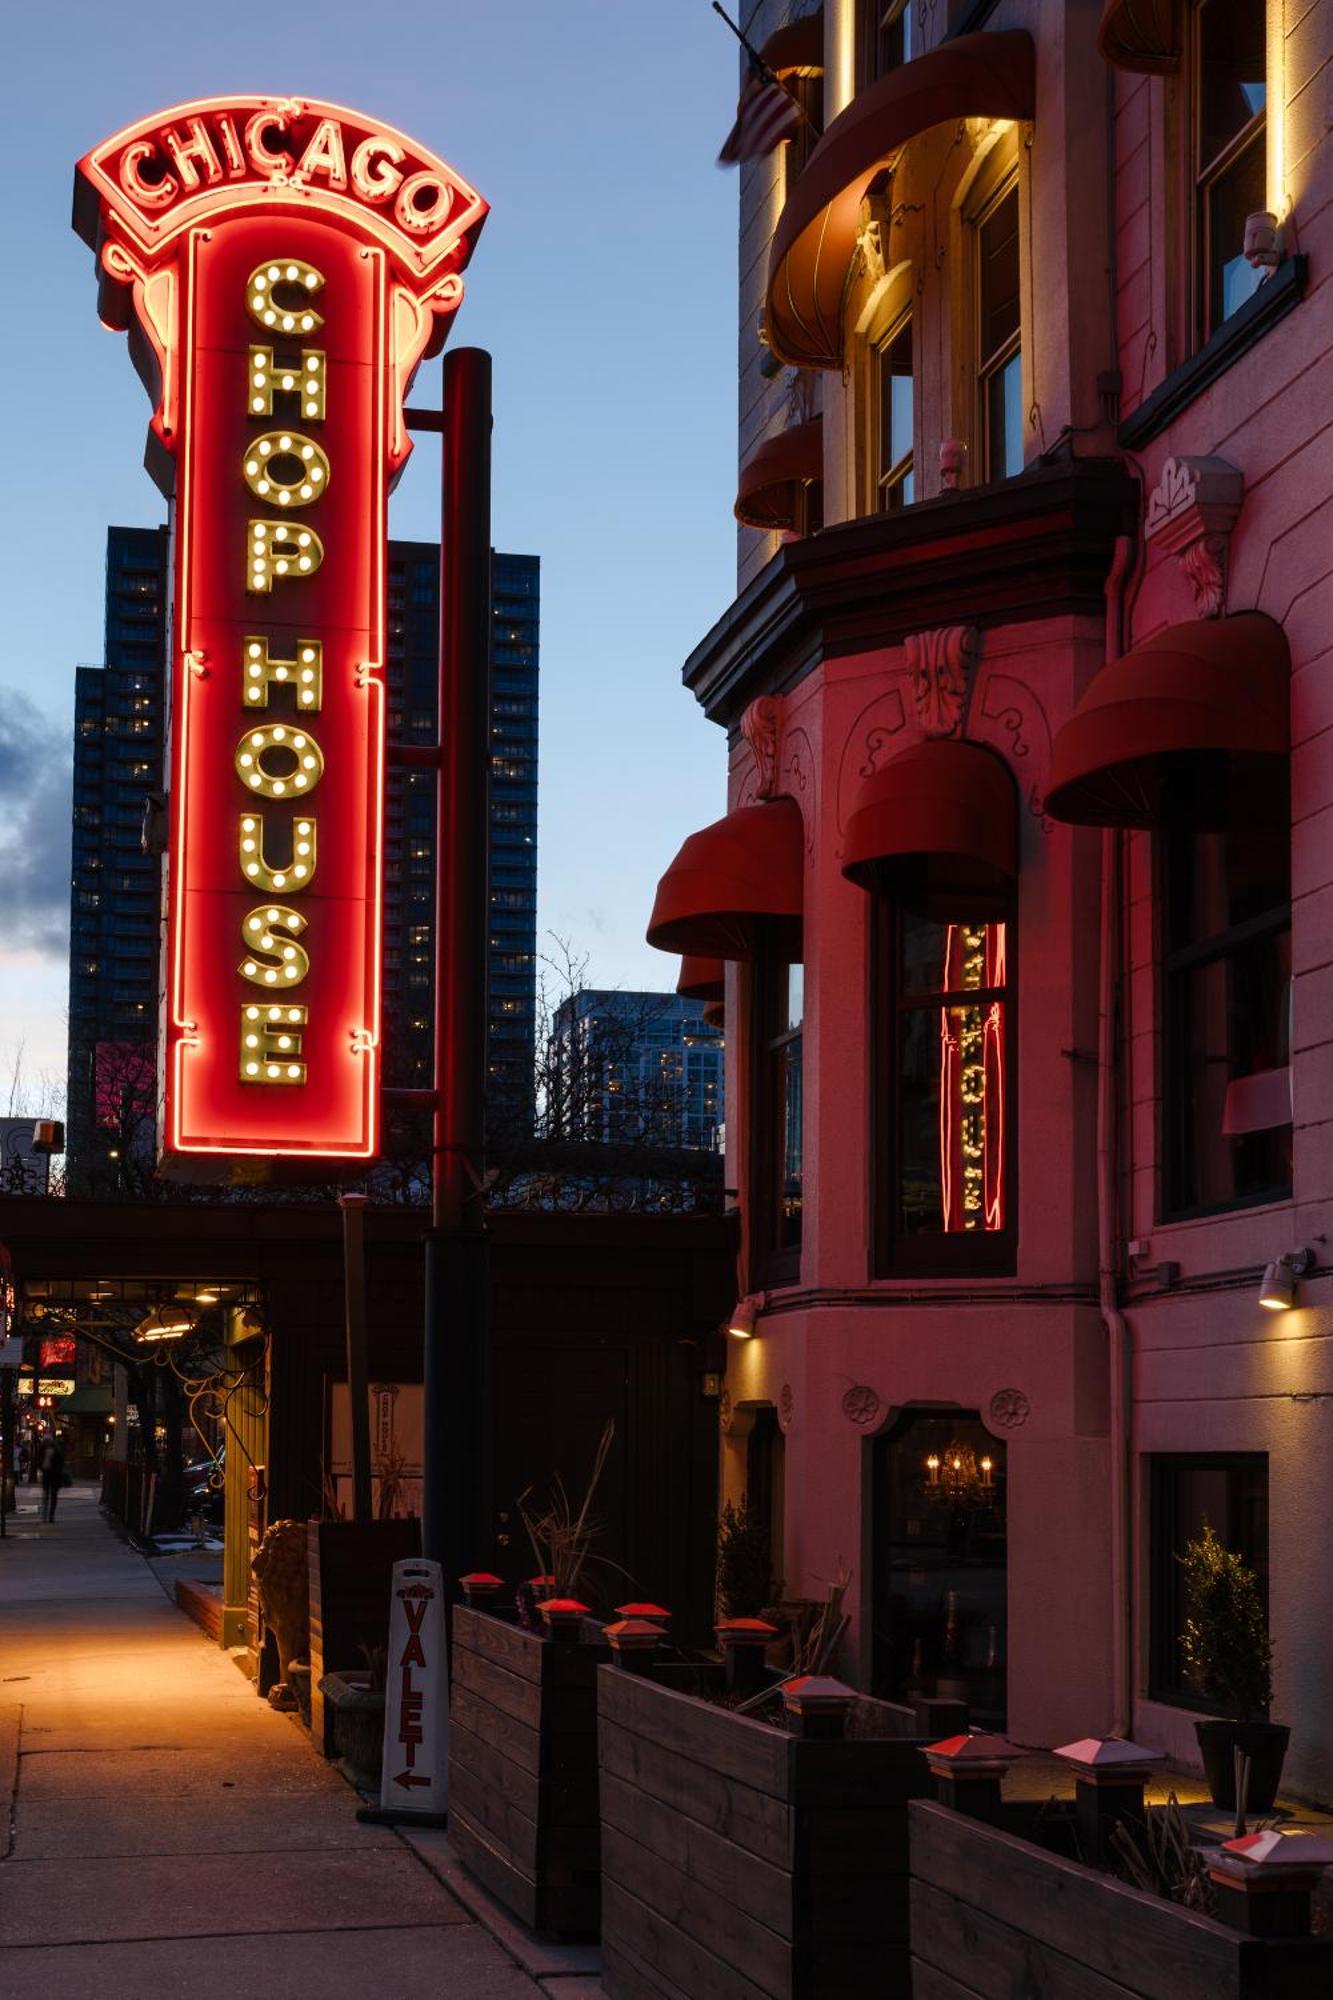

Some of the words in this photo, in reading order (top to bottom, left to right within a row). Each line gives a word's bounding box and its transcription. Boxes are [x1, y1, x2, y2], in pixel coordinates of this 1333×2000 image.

[119, 112, 455, 234] CHICAGO
[243, 258, 330, 594] CHOP
[234, 635, 325, 1087] HOUSE
[398, 1600, 428, 1767] VALET
